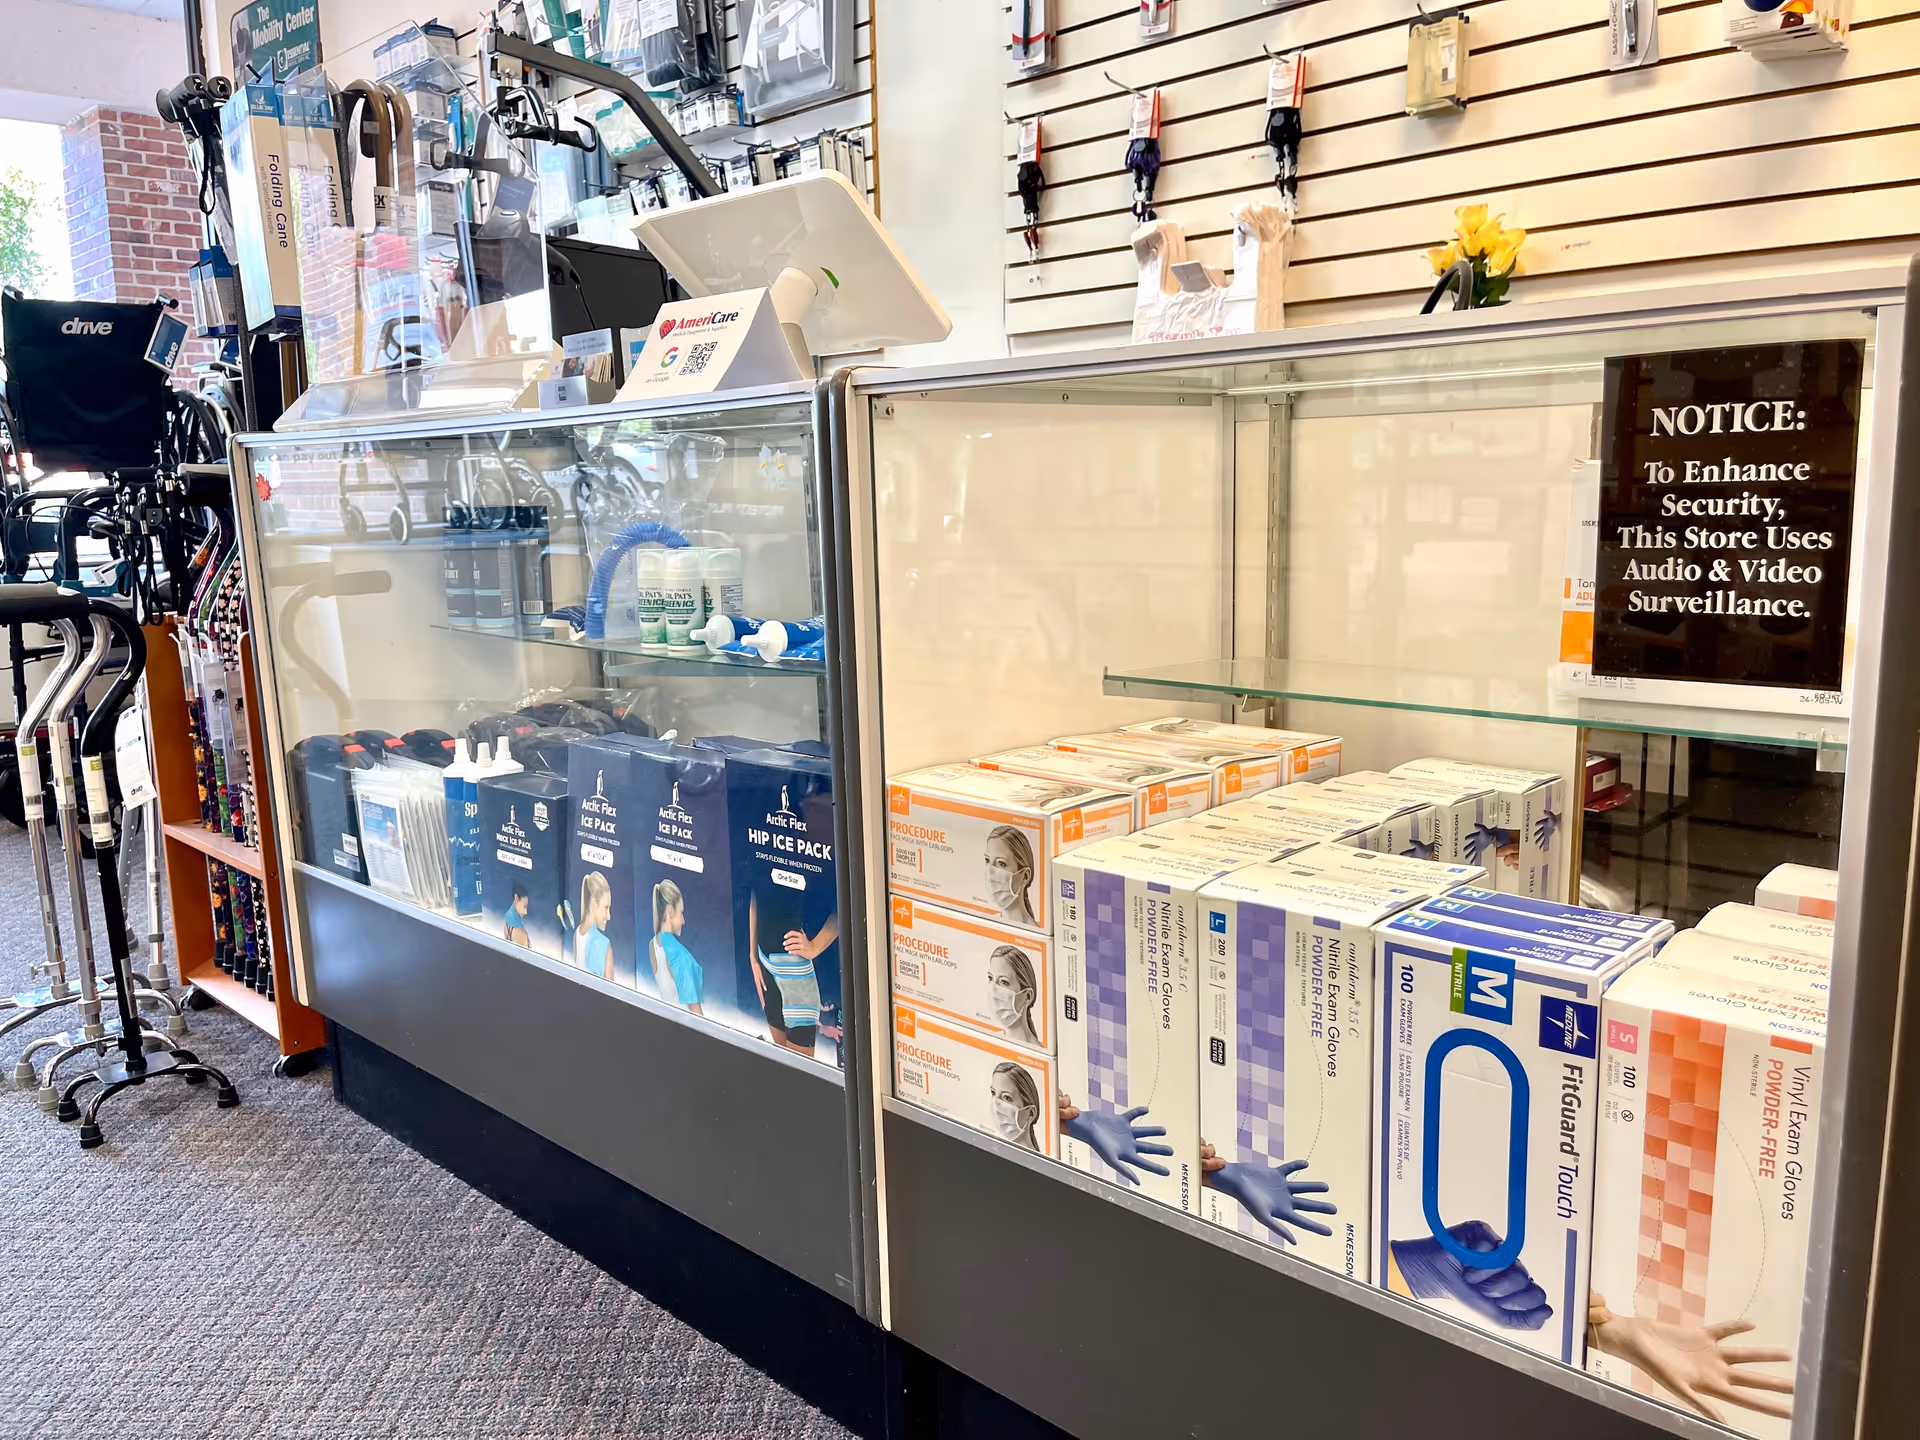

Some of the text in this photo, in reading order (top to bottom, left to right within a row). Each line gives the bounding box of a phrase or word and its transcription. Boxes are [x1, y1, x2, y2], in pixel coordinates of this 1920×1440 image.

[257, 6, 270, 23] The
[252, 6, 315, 49] Mobility Center
[262, 182, 271, 209] Comfort
[268, 154, 288, 248] Folding Cane
[323, 165, 338, 218] Folding
[61, 317, 113, 335] drive
[676, 311, 739, 331] AmeriCare
[164, 341, 179, 369] drive
[1650, 400, 1807, 437] NOTICE:
[1644, 457, 1810, 485] To Enhance
[1661, 492, 1785, 523] Security,
[1617, 524, 1833, 550] This Store Uses
[1622, 557, 1822, 584] Audio & Video
[675, 592, 692, 600] PAT'S
[682, 600, 695, 608] ICE
[1628, 590, 1811, 618] Surveillance.
[581, 798, 617, 818] Arctic Flex
[659, 807, 693, 825] Arctic Flex
[502, 824, 526, 838] Arctic Flex
[581, 814, 616, 834] ICE PACK
[659, 821, 693, 840] ICE PACK
[766, 812, 808, 832] Arctic Flex
[890, 820, 946, 844] PROCEDURE
[496, 833, 509, 843] NECK
[509, 836, 518, 846] ICE
[518, 839, 532, 849] PACK
[748, 828, 832, 861] HIP ICE PACK
[890, 833, 954, 854] FACE MASK WITH EARLOOPS
[755, 852, 822, 873] STAYS FLEXIBLE WHEN FROZEN
[896, 853, 916, 863] DROPLET
[778, 872, 799, 885] One Size
[891, 872, 897, 880] 50
[1067, 883, 1075, 899] XL
[1461, 889, 1489, 899] M
[1433, 901, 1463, 911] M
[1215, 919, 1225, 927] L
[1401, 917, 1430, 928] M
[1769, 923, 1822, 937] Gloves
[1562, 928, 1595, 939] Touch
[893, 932, 949, 959] PROCEDURE
[1147, 898, 1158, 994] POWDER-FREE
[1218, 938, 1226, 956] 200
[1532, 946, 1566, 957] Touch
[893, 945, 958, 970] FACE MASK WITH EARLOOPS
[1161, 901, 1173, 1030] Nitrile Exam Gloves
[1732, 954, 1789, 971] Gloves
[899, 965, 920, 976] DROPLET
[1400, 964, 1414, 993] 100
[1453, 962, 1463, 999] NITRILE
[1311, 935, 1323, 1039] POWDER-FREE
[1470, 966, 1508, 1009] M
[1328, 938, 1341, 1078] Nitrile Exam Gloves
[1348, 1007, 1359, 1024] 3.5
[1688, 991, 1798, 1020] Exam Gloves
[1348, 1028, 1360, 1038] C
[1564, 1004, 1574, 1049] MEDLINE
[1619, 1031, 1634, 1044] S
[897, 1040, 952, 1071] PROCEDURE
[897, 1052, 961, 1081] FACE MASK WITH EARLOOPS
[914, 1070, 923, 1078] FOR
[1750, 1054, 1759, 1097] NON-STERILE
[903, 1073, 923, 1084] DROPLET
[1623, 1065, 1636, 1089] 100
[1612, 1101, 1618, 1111] DO
[1759, 1058, 1784, 1179] POWDER-FREE
[1781, 1066, 1811, 1220] Vinyl Exam Gloves
[1403, 1151, 1409, 1160] DE
[1556, 1164, 1579, 1219] Touch
